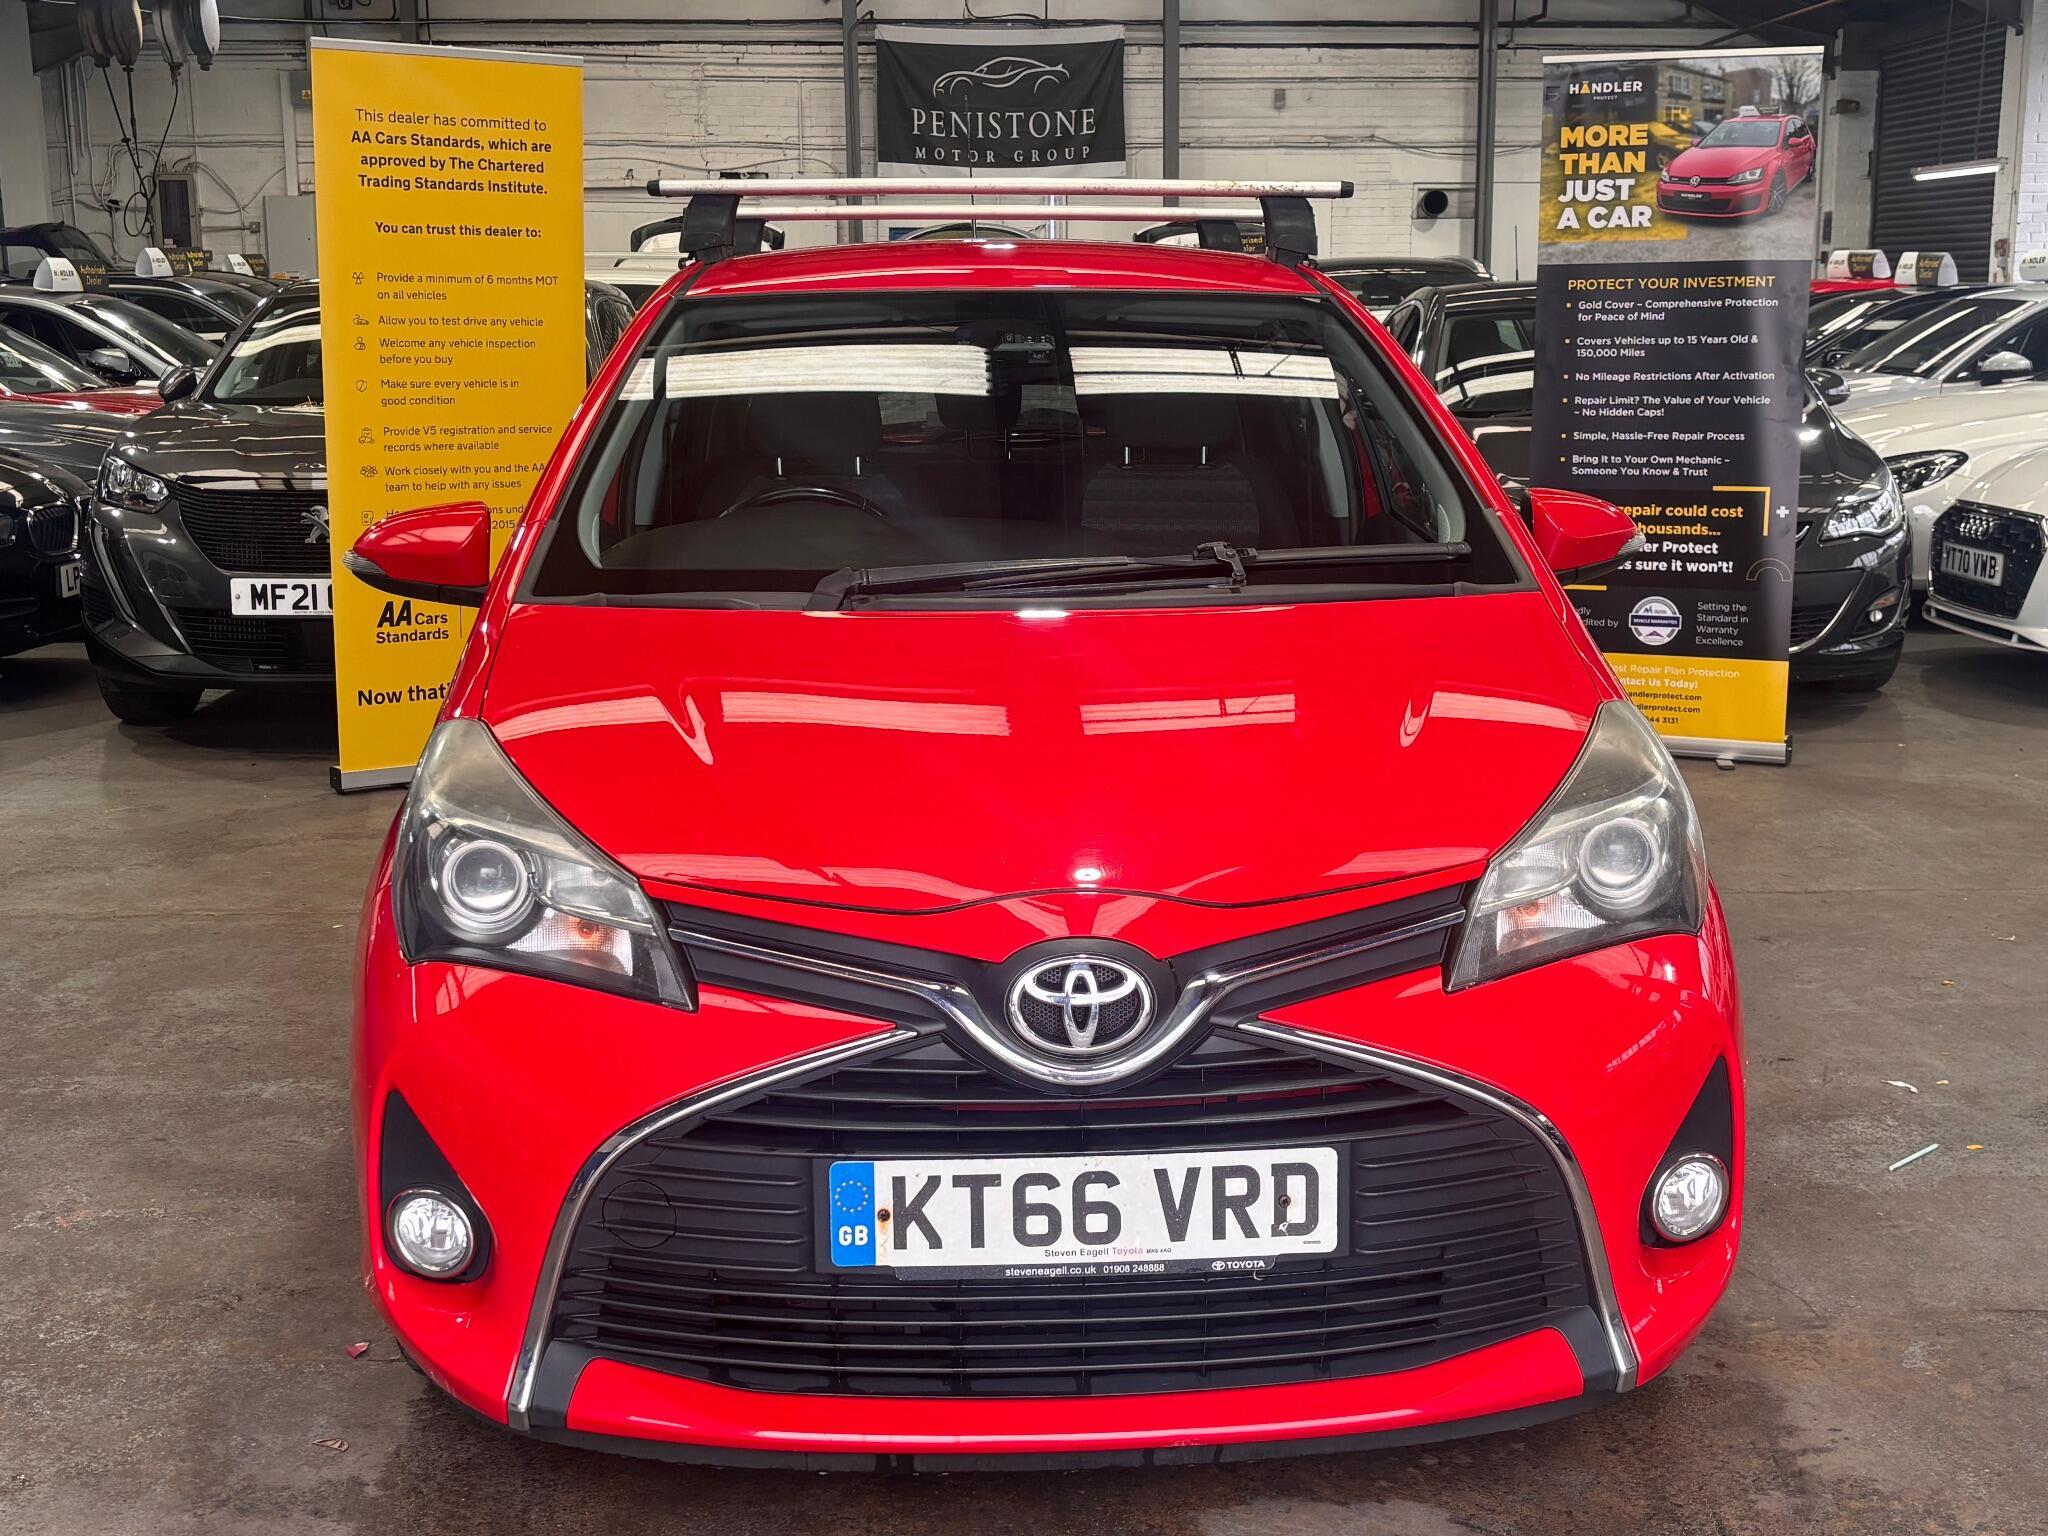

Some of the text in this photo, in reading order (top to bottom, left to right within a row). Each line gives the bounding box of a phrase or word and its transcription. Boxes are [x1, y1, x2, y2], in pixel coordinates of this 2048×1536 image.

[355, 108, 529, 130] This dealer has committed
[911, 108, 1097, 139] PENISTONE
[351, 131, 552, 153] AA Cars Standards, which are
[1560, 124, 1649, 148] MORE
[915, 146, 1090, 163] MOTOR GROUP
[360, 154, 544, 173] approved by The Chartered
[1559, 151, 1646, 175] THAN
[358, 174, 548, 195] Trading Standards Institute.
[1558, 178, 1635, 203] JUST
[1556, 205, 1652, 230] A CAR
[375, 222, 522, 238] You can trust this dealer
[377, 273, 558, 286] Provide minimum 6 months MOT
[1568, 276, 1776, 291] PROTECT YOUR INVESTMENT
[407, 290, 447, 301] vehicles
[1578, 298, 1779, 310] Gold Cover Comprehensive Protection
[378, 315, 544, 328] Allow you test drive any vehicle
[1595, 311, 1665, 321] Peace Mind
[379, 338, 536, 350] Welcome any vehicle inspection
[1577, 334, 1748, 346] Covers Vehicles 15 Years Old
[1576, 348, 1645, 358] 150,000 Miles
[379, 354, 453, 366] before you buy
[1592, 371, 1775, 382] Mileage Restrictions After Activation
[380, 378, 498, 391] Make sure every vehicle
[381, 395, 456, 407] good condition
[1575, 395, 1771, 406] Repair Limit? Value Your Vehicle
[1599, 407, 1665, 418] Hidden Caps!
[383, 424, 552, 437] Provide registration service
[1573, 431, 1746, 442] Simple, Hassle-Free Repair Process
[383, 440, 499, 453] records where available
[1572, 455, 1722, 465] Bring Your Mechanic
[384, 464, 491, 477] Work closely with you
[1571, 467, 1708, 477] Someone Know Trust
[385, 479, 522, 493] team help with any issues
[507, 504, 523, 514] und
[1665, 505, 1707, 517] could
[1711, 506, 1744, 517] cost
[493, 520, 515, 529] 2015
[1636, 522, 1721, 536] housands...
[1662, 541, 1719, 554] Protect
[1635, 560, 1668, 571] sure
[1686, 561, 1734, 573] won't!
[66, 566, 80, 592] LP
[250, 583, 318, 611] MF21
[377, 600, 448, 628] AA Cars
[1697, 602, 1730, 613] Setting
[1697, 613, 1738, 624] Standard
[376, 627, 449, 644] Standards
[1696, 625, 1738, 636] Warranty
[1696, 636, 1744, 647] Excellence
[1630, 664, 1740, 678] Repair Plan Protection
[1620, 677, 1698, 690] ntact Today!
[358, 688, 402, 707] Now
[1629, 690, 1702, 701] andlerprotect.com
[1662, 716, 1679, 725] 3131
[892, 1162, 1320, 1250] KT66 VRD
[838, 1225, 869, 1246] GB
[1044, 1249, 1077, 1257] Steven
[1079, 1248, 1109, 1258] Eagell
[1111, 1247, 1144, 1256] Toyota
[1005, 1265, 1097, 1277] steveneagell.co.uk
[1226, 1260, 1266, 1269] TOYOTA
